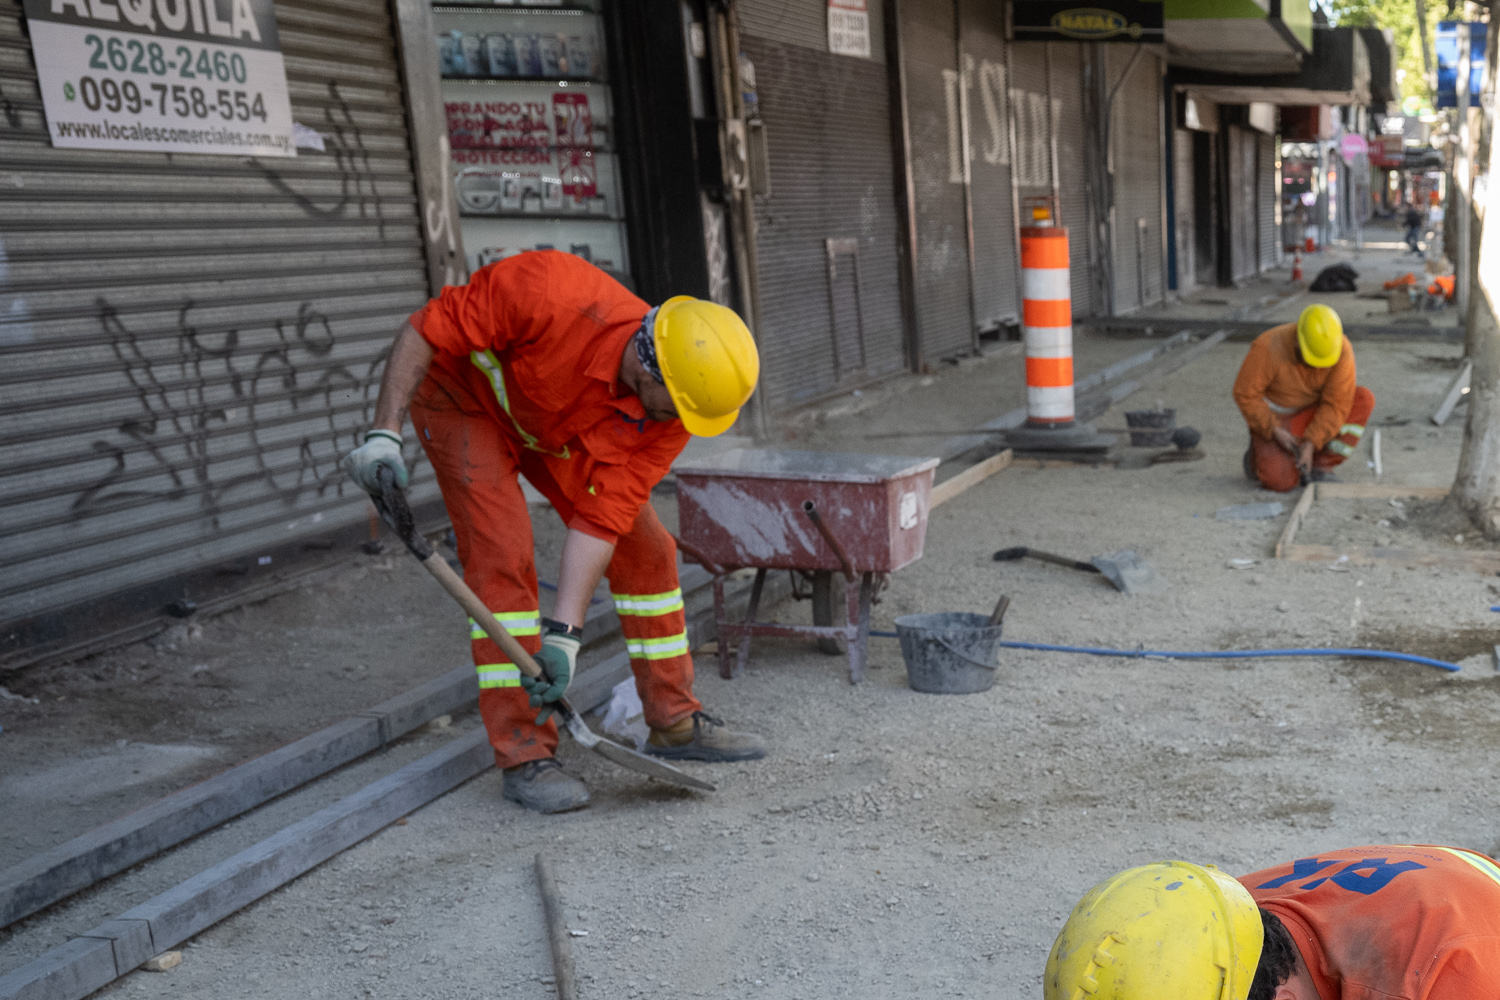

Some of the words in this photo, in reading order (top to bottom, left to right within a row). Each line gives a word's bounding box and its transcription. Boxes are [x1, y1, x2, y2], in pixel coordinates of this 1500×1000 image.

[85, 34, 247, 84] 2628-2460
[79, 76, 268, 123] 099-758-554
[55, 119, 291, 149] www.localescomerciales.com.uy
